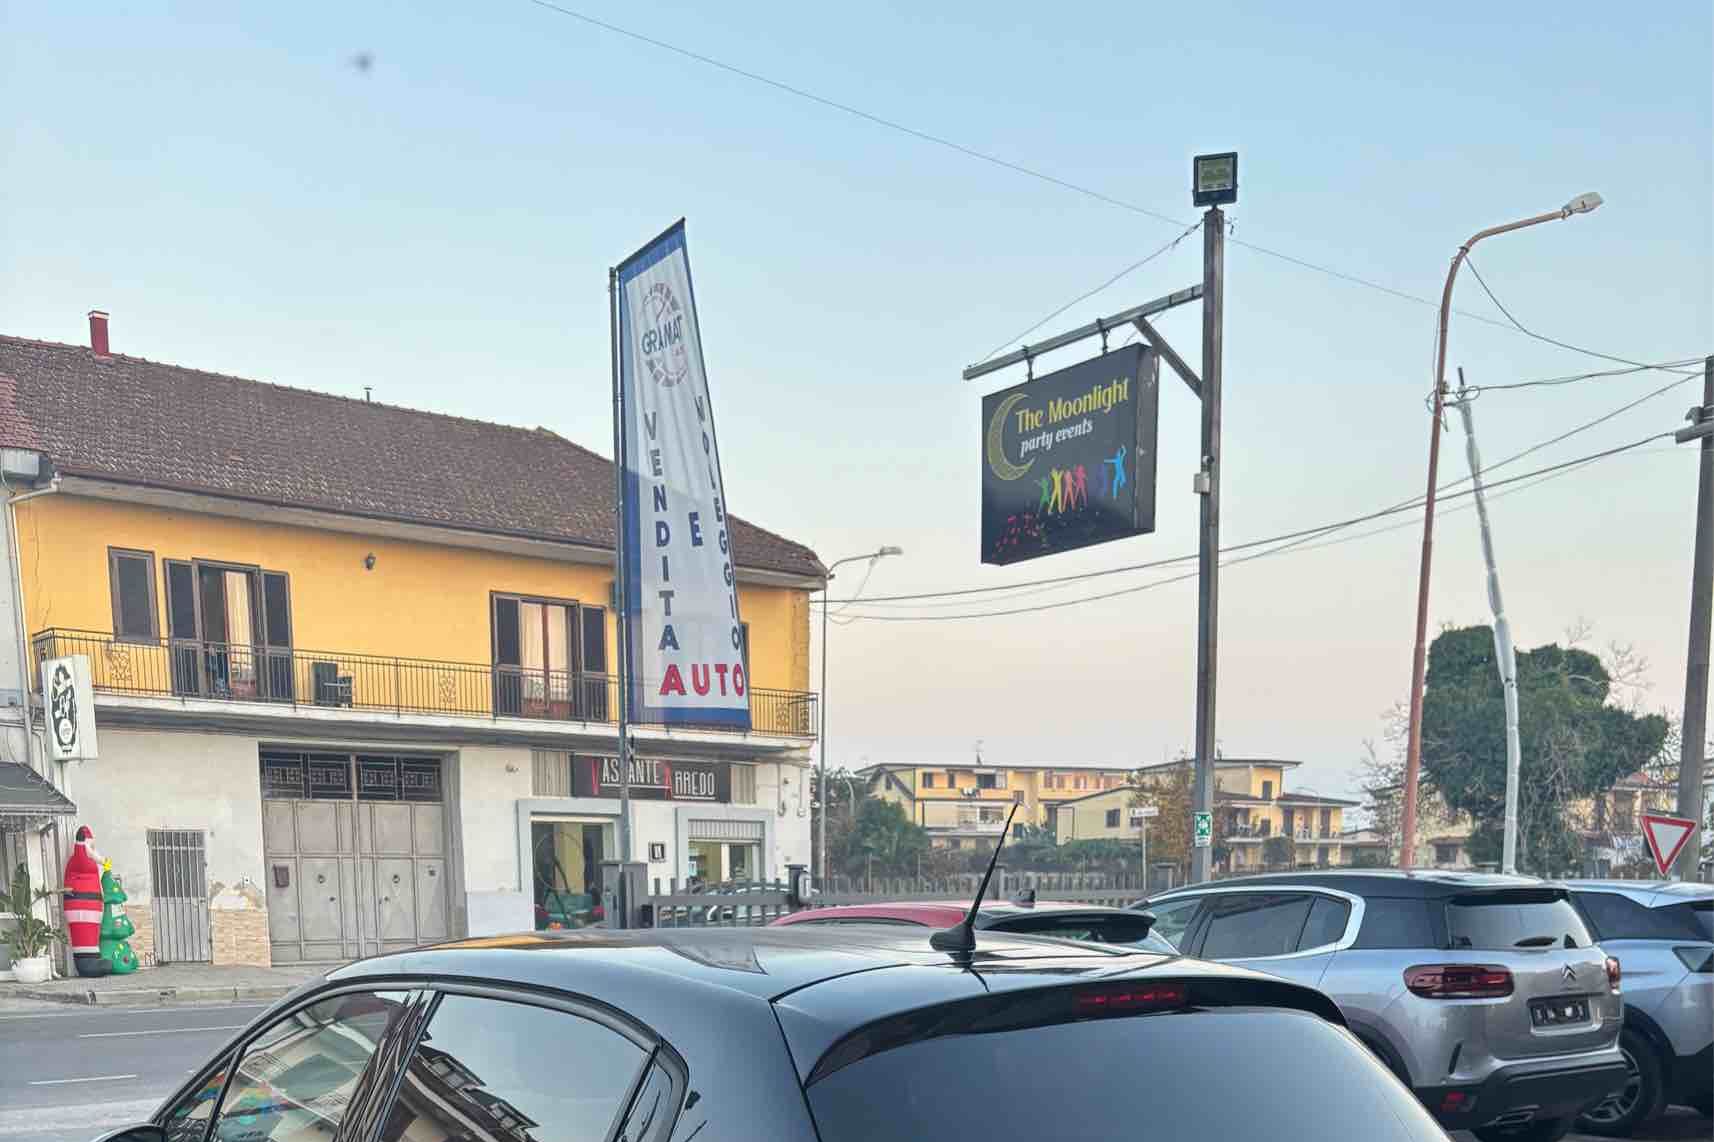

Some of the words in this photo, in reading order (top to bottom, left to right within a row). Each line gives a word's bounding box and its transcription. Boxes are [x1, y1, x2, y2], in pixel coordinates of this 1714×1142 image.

[1015, 407, 1044, 433] The
[1047, 377, 1129, 424] Moonlight
[1020, 431, 1053, 458] party
[1055, 418, 1093, 443] events
[644, 410, 680, 651] VENDITA
[689, 511, 703, 547] E
[658, 663, 744, 697] AUTO
